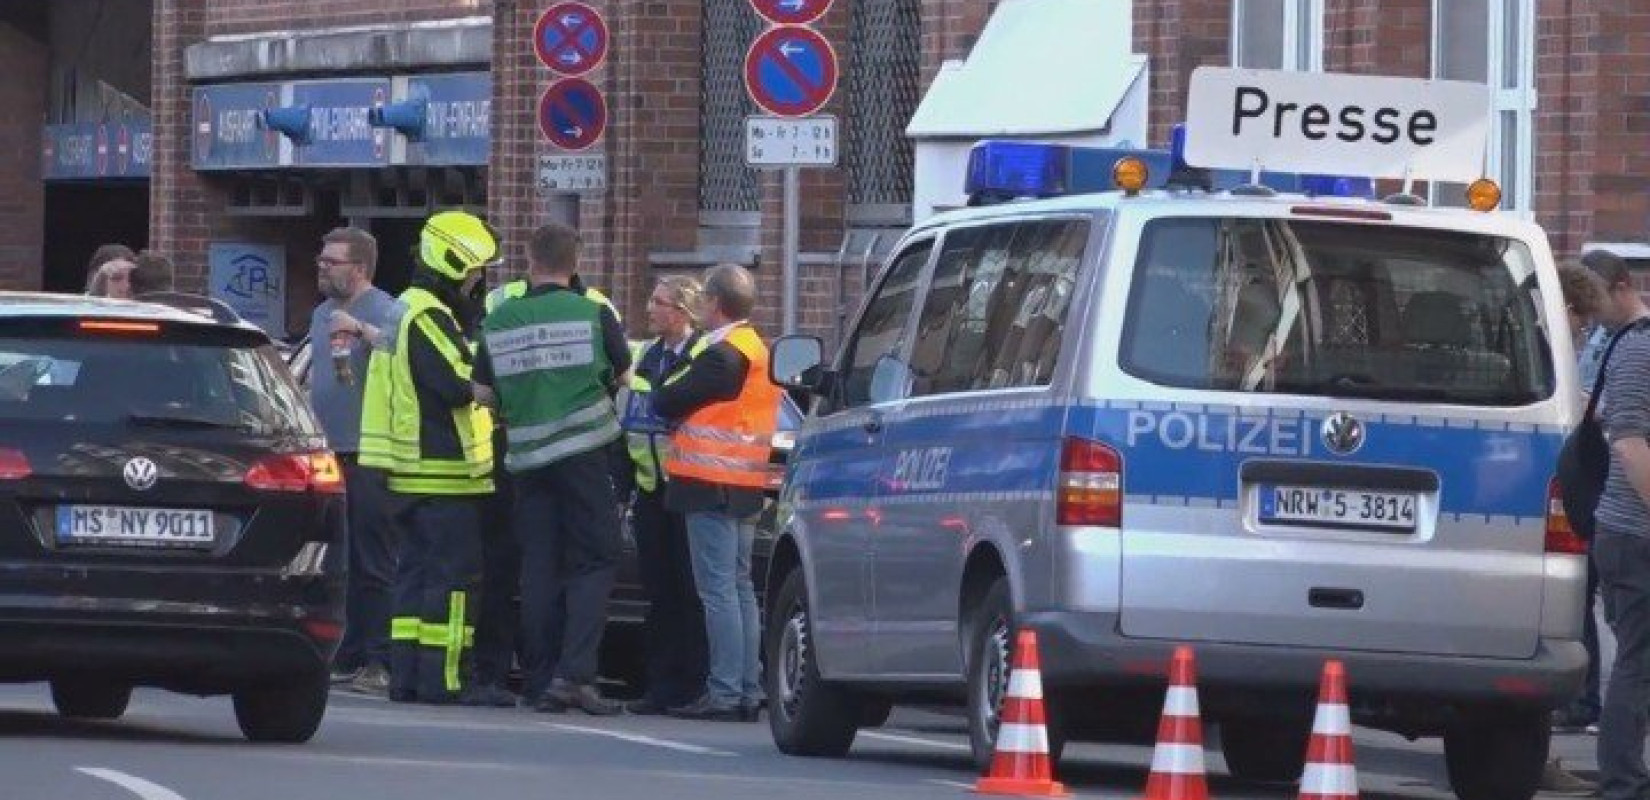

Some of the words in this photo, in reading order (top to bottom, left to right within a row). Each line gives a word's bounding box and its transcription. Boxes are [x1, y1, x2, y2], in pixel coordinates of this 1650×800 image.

[1232, 86, 1438, 145] Presse
[1126, 410, 1311, 456] POLIZEI
[1275, 490, 1319, 515] NRW
[74, 508, 104, 533] MS
[120, 510, 150, 535] NY
[155, 511, 211, 537] 9011
